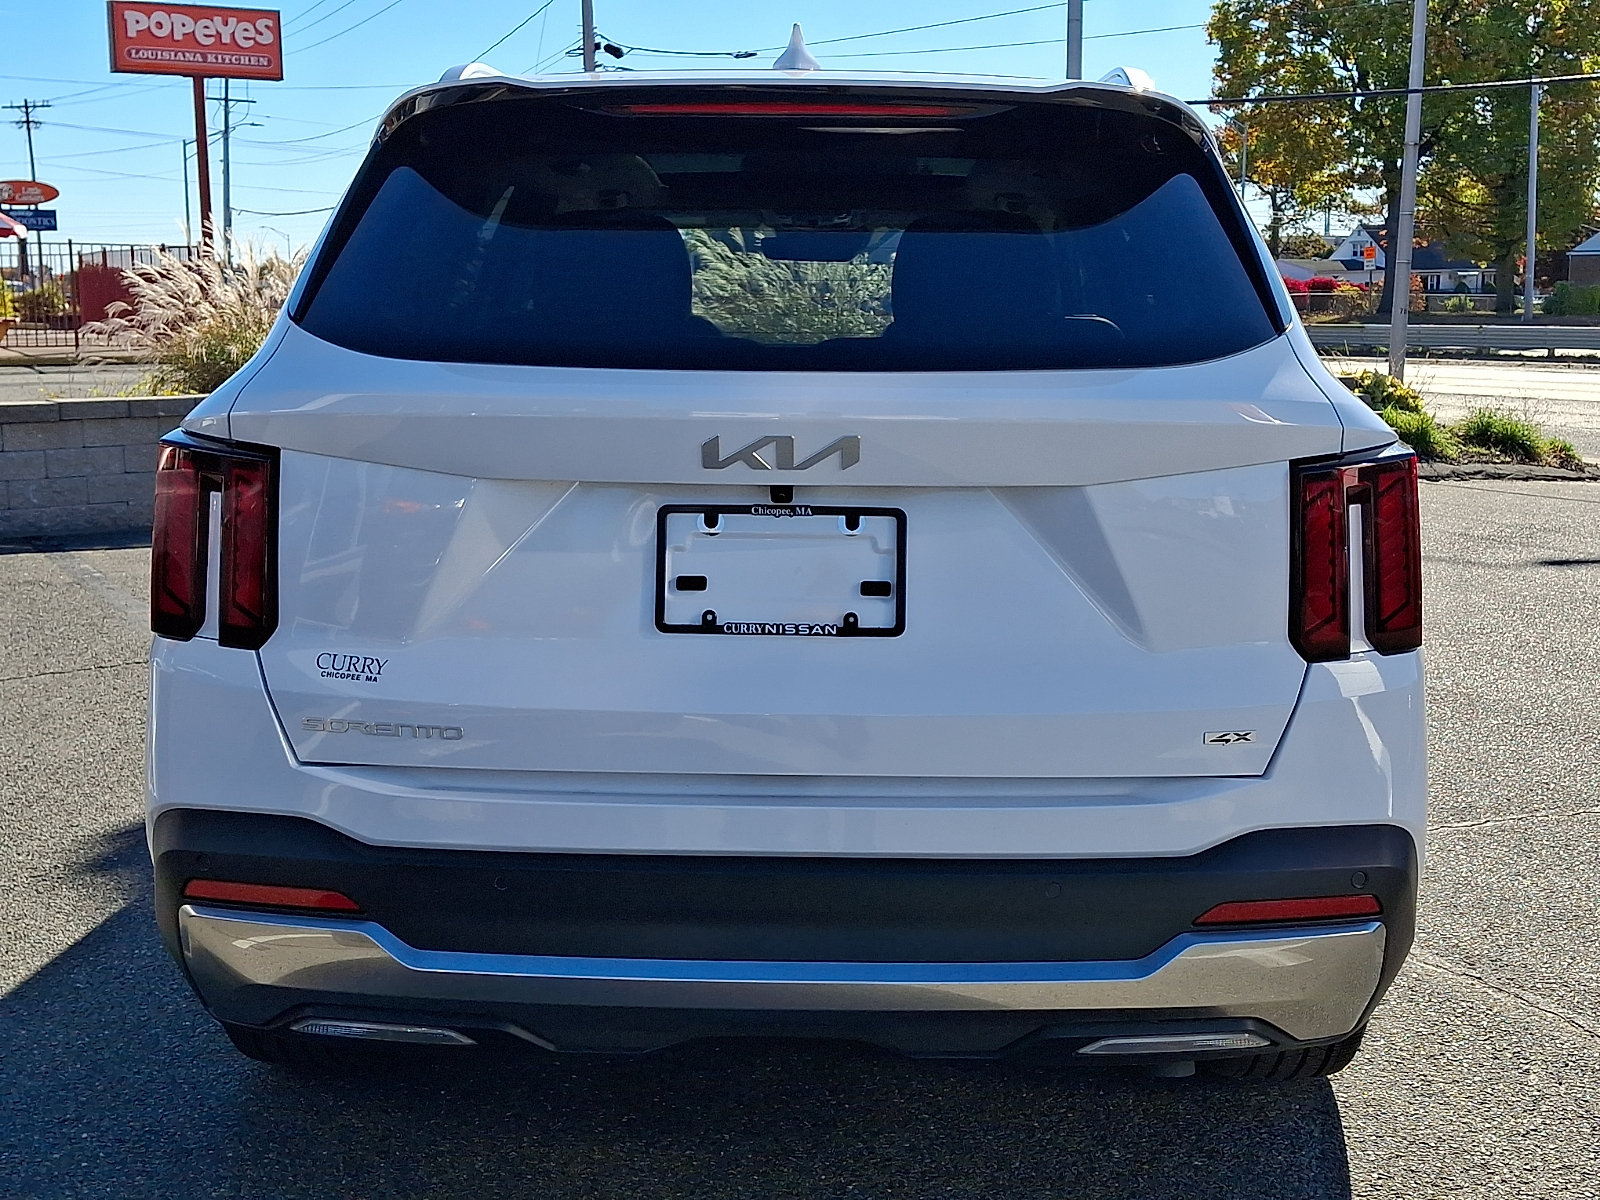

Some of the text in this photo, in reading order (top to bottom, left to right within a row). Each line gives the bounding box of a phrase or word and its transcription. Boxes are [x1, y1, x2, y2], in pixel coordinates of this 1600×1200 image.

[130, 48, 269, 66] LOUISIANA KITCHEN
[702, 434, 860, 470] KIA
[751, 506, 813, 517] Chicopee, MA
[316, 652, 389, 676] CURRY
[320, 670, 379, 683] CHICOPEE MA
[302, 717, 464, 740] SORENTO
